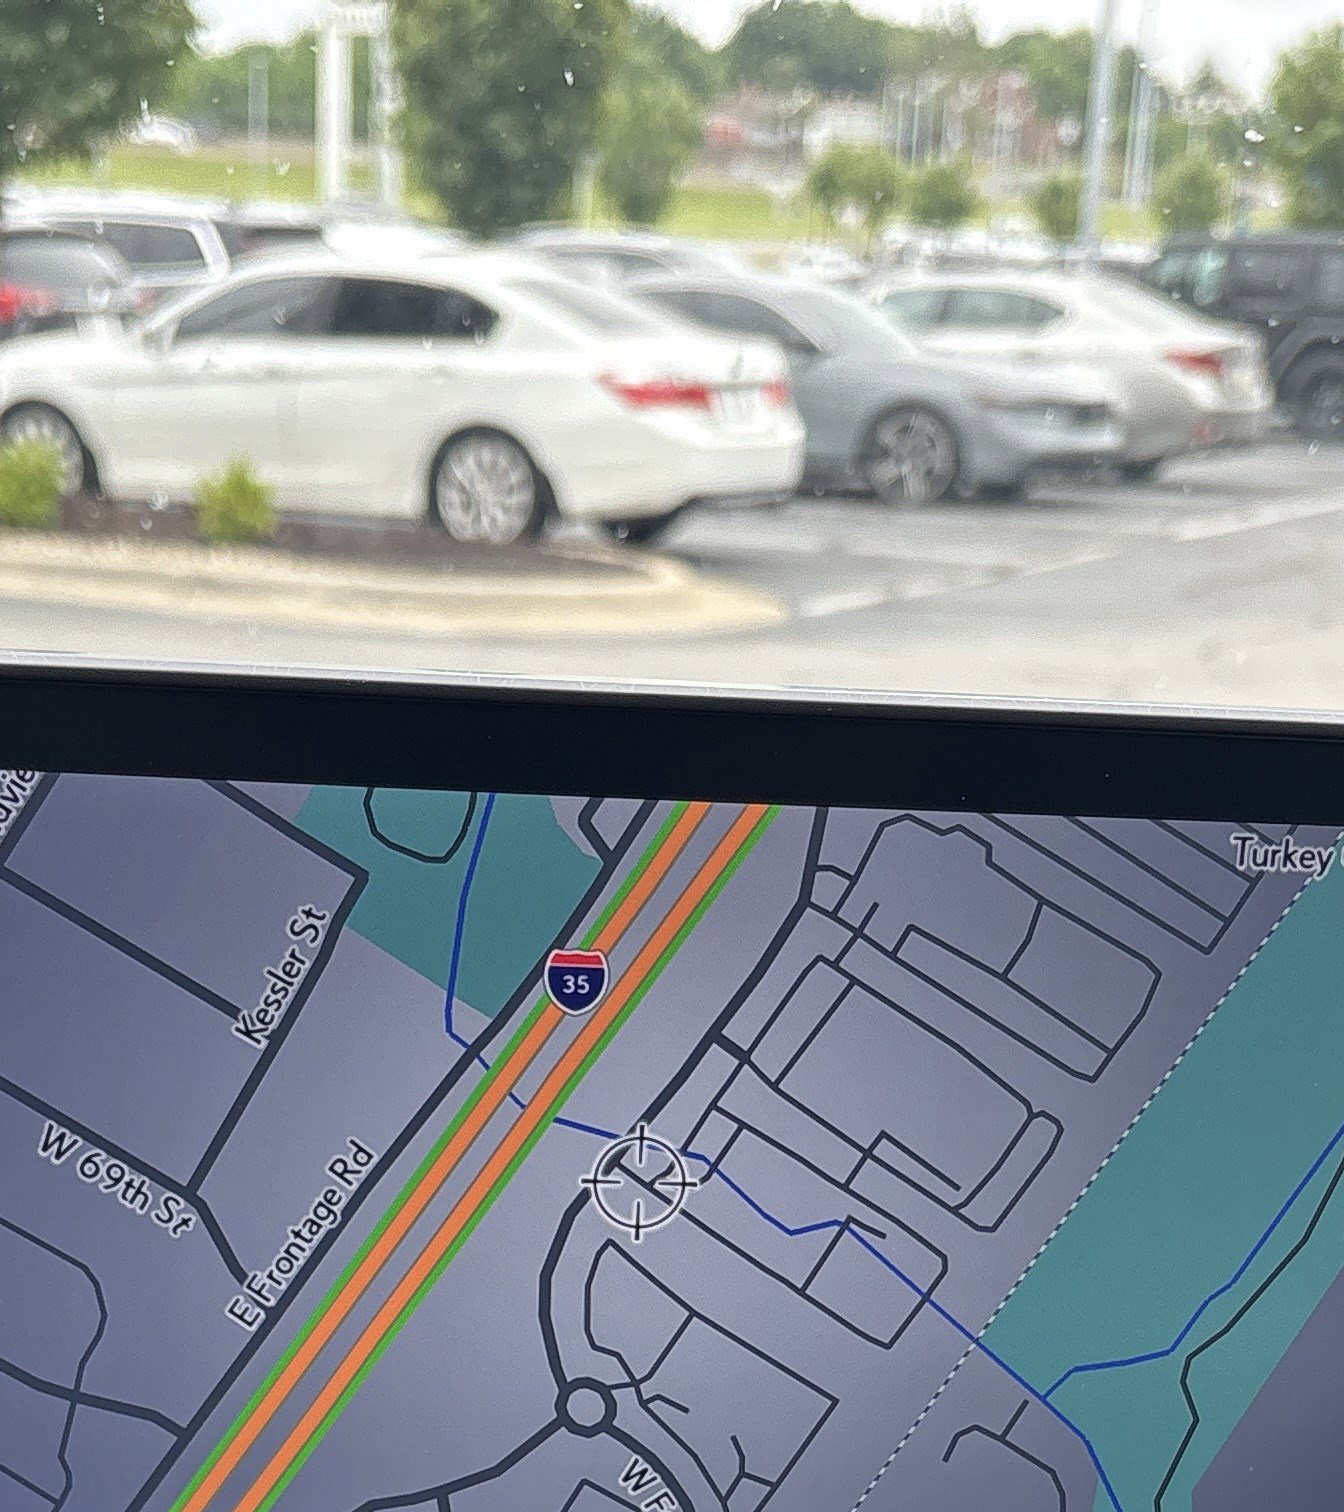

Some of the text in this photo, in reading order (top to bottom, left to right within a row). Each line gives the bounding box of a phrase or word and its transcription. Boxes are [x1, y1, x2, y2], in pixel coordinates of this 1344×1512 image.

[1231, 834, 1337, 879] Turkey
[233, 905, 328, 1047] Kessler St
[561, 973, 592, 996] 35
[40, 1120, 195, 1237] W 69th St
[225, 1136, 376, 1330] E Frontage Rd
[619, 1455, 660, 1494] W
